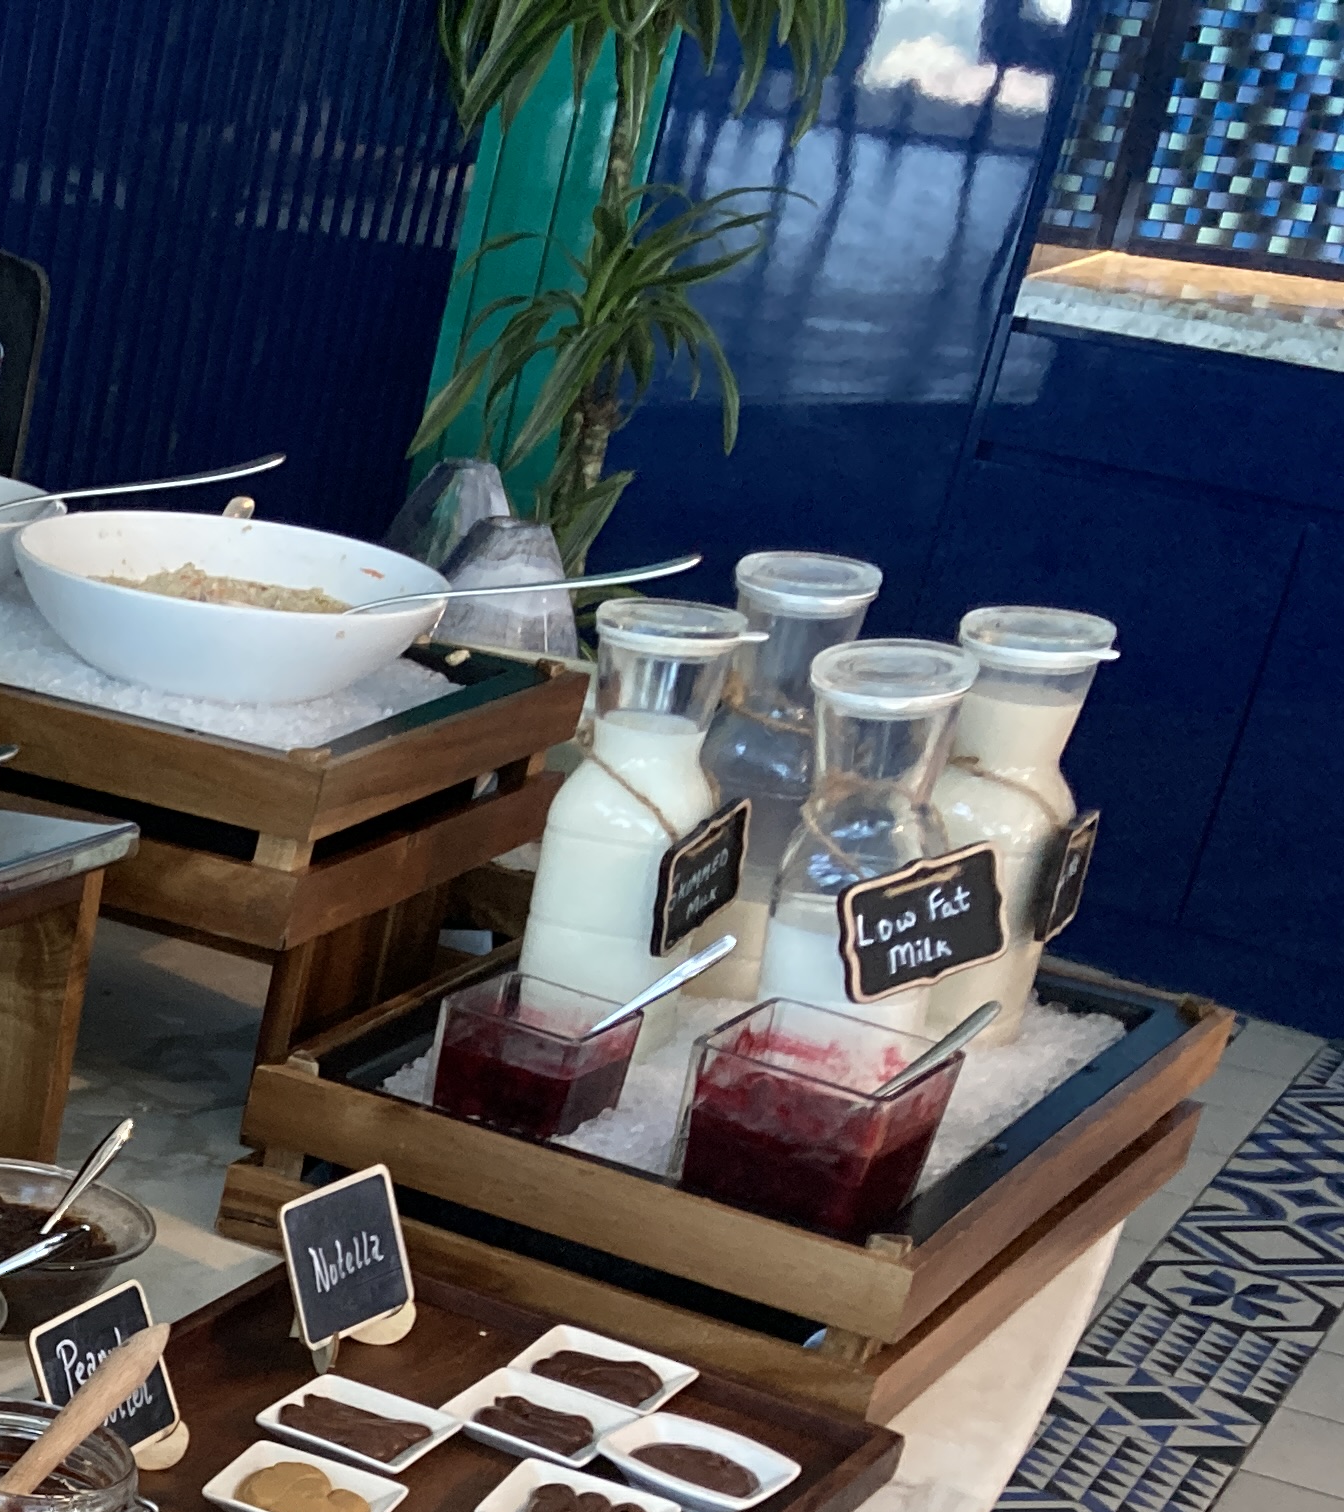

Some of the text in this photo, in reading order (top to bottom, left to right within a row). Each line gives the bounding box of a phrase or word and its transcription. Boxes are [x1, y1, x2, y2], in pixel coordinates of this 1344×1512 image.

[856, 885, 971, 947] Low Fat
[55, 1326, 124, 1399] Pean
